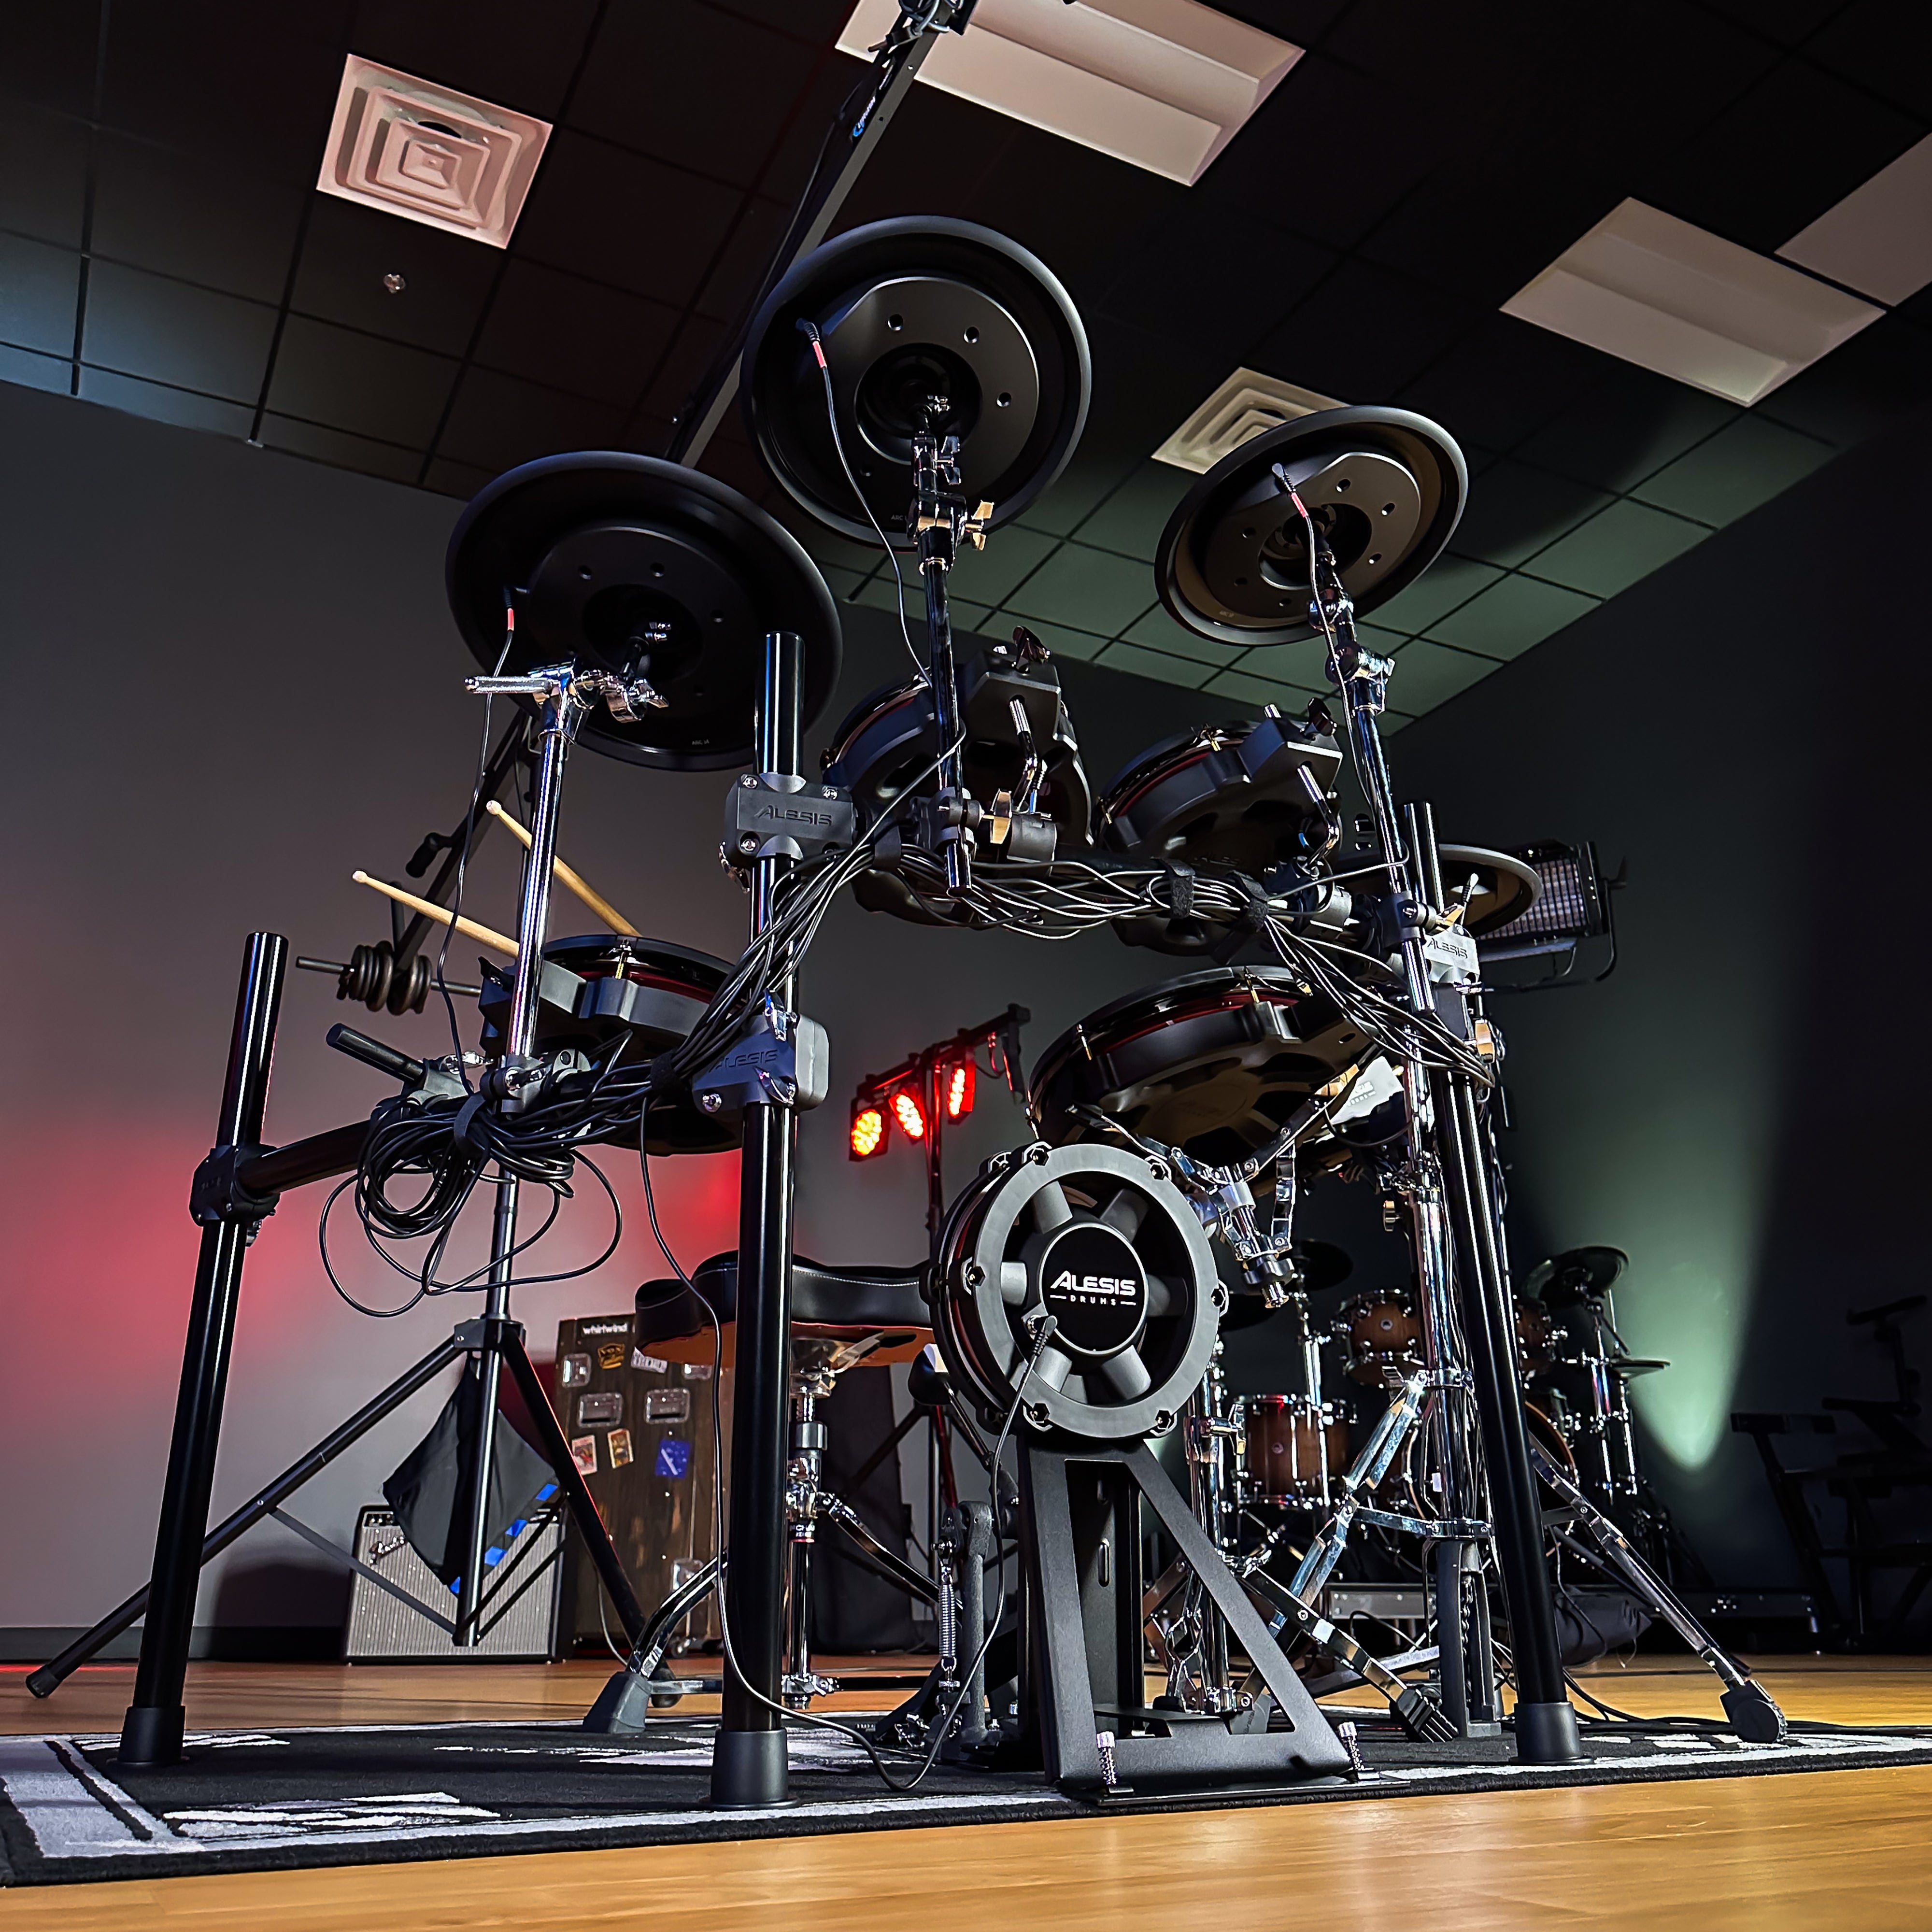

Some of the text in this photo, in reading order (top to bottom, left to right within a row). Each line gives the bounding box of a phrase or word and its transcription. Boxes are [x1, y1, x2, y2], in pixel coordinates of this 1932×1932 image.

[753, 804, 832, 826] ALESIS
[1427, 937, 1468, 959] ALESIS
[1050, 1270, 1136, 1296] ALESIS
[1070, 1294, 1117, 1306] DRUMS
[582, 1322, 628, 1335] whirlwind
